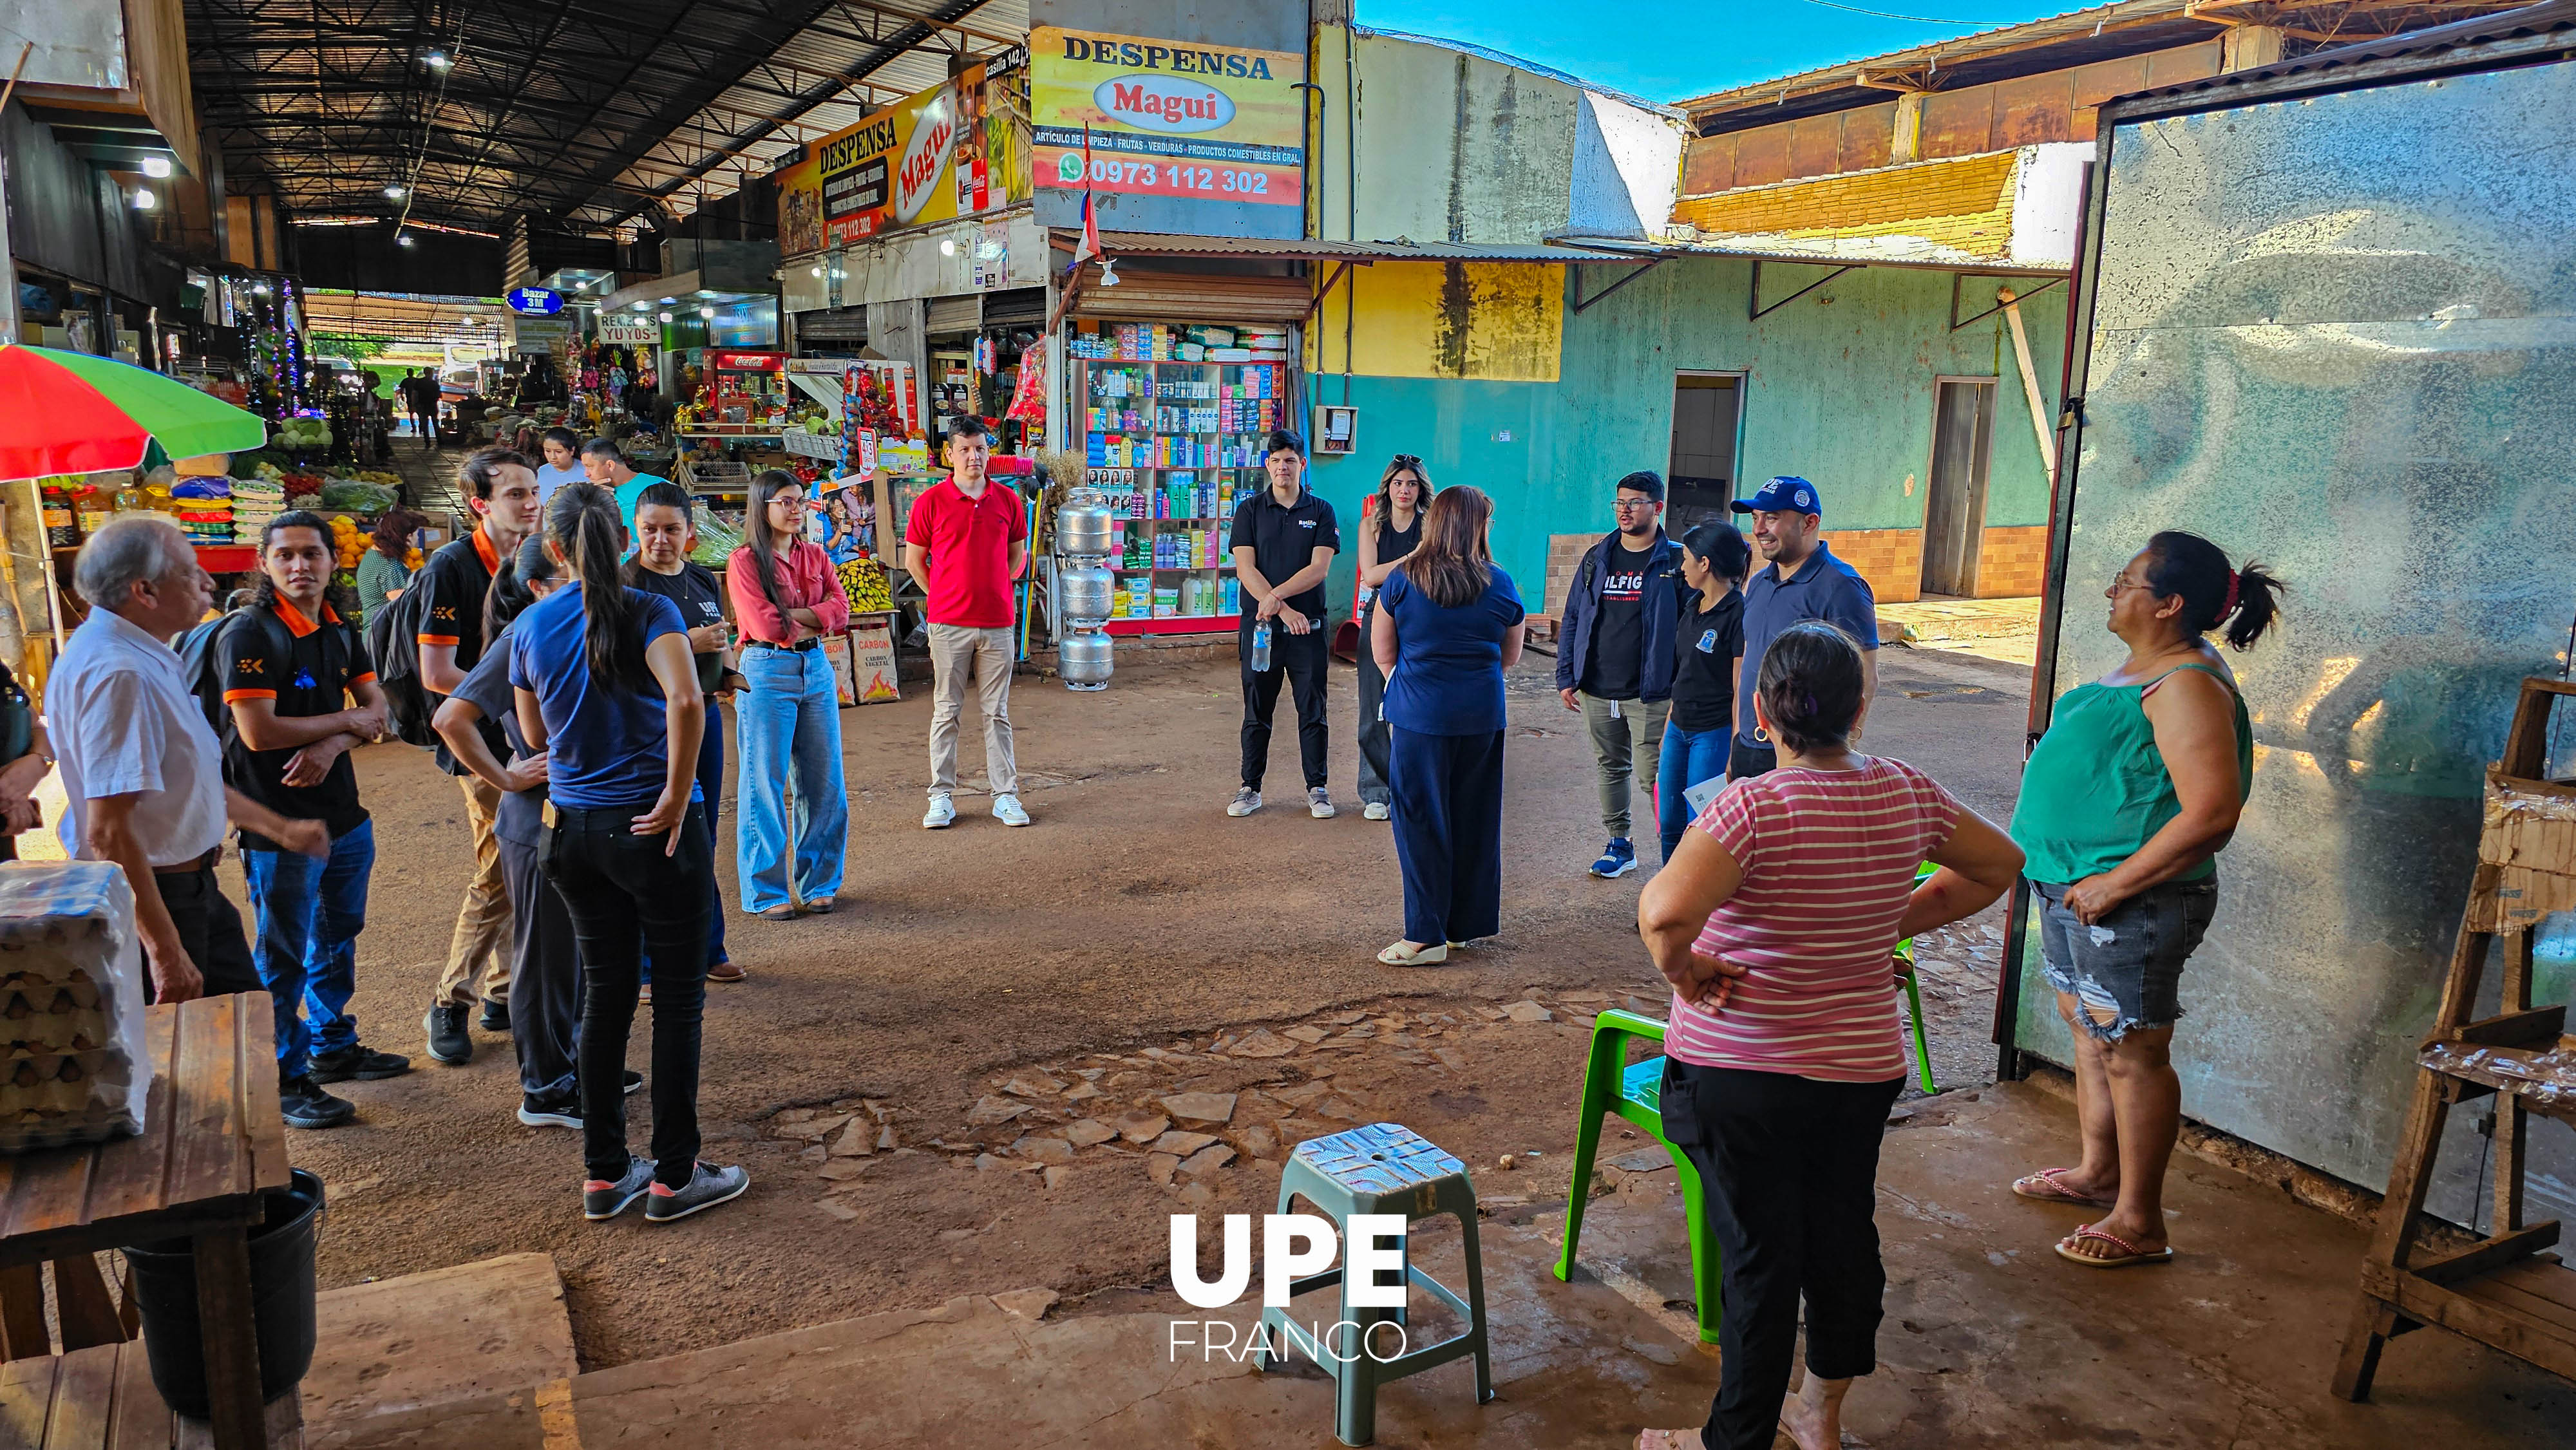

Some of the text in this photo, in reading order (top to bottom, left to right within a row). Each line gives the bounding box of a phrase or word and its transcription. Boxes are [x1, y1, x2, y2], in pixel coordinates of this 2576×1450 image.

[986, 57, 1006, 77] casilla
[1007, 49, 1019, 67] 142
[1063, 36, 1273, 80] DESPENSA
[1113, 82, 1217, 123] Magui
[819, 117, 897, 174] DESPENSA
[901, 95, 951, 210] Magui
[1036, 131, 1070, 144] ARTÍCULO
[1072, 135, 1081, 144] DE
[1083, 135, 1113, 147] LMPIEZA
[1117, 138, 1143, 150] FRUTAS
[1148, 140, 1183, 154] VERDURAS
[1188, 144, 1226, 158] PRODUCTOS
[1227, 148, 1271, 161] COMESTIBLES
[1272, 152, 1281, 162] EN
[1282, 152, 1300, 163] GRAL.
[1090, 159, 1268, 194] 0973 112 302
[848, 220, 858, 237] 112
[859, 216, 871, 234] 302
[522, 288, 549, 299] Bazar
[527, 297, 544, 308] 3M
[604, 328, 650, 340] YUYOS
[858, 639, 889, 650] CARBON
